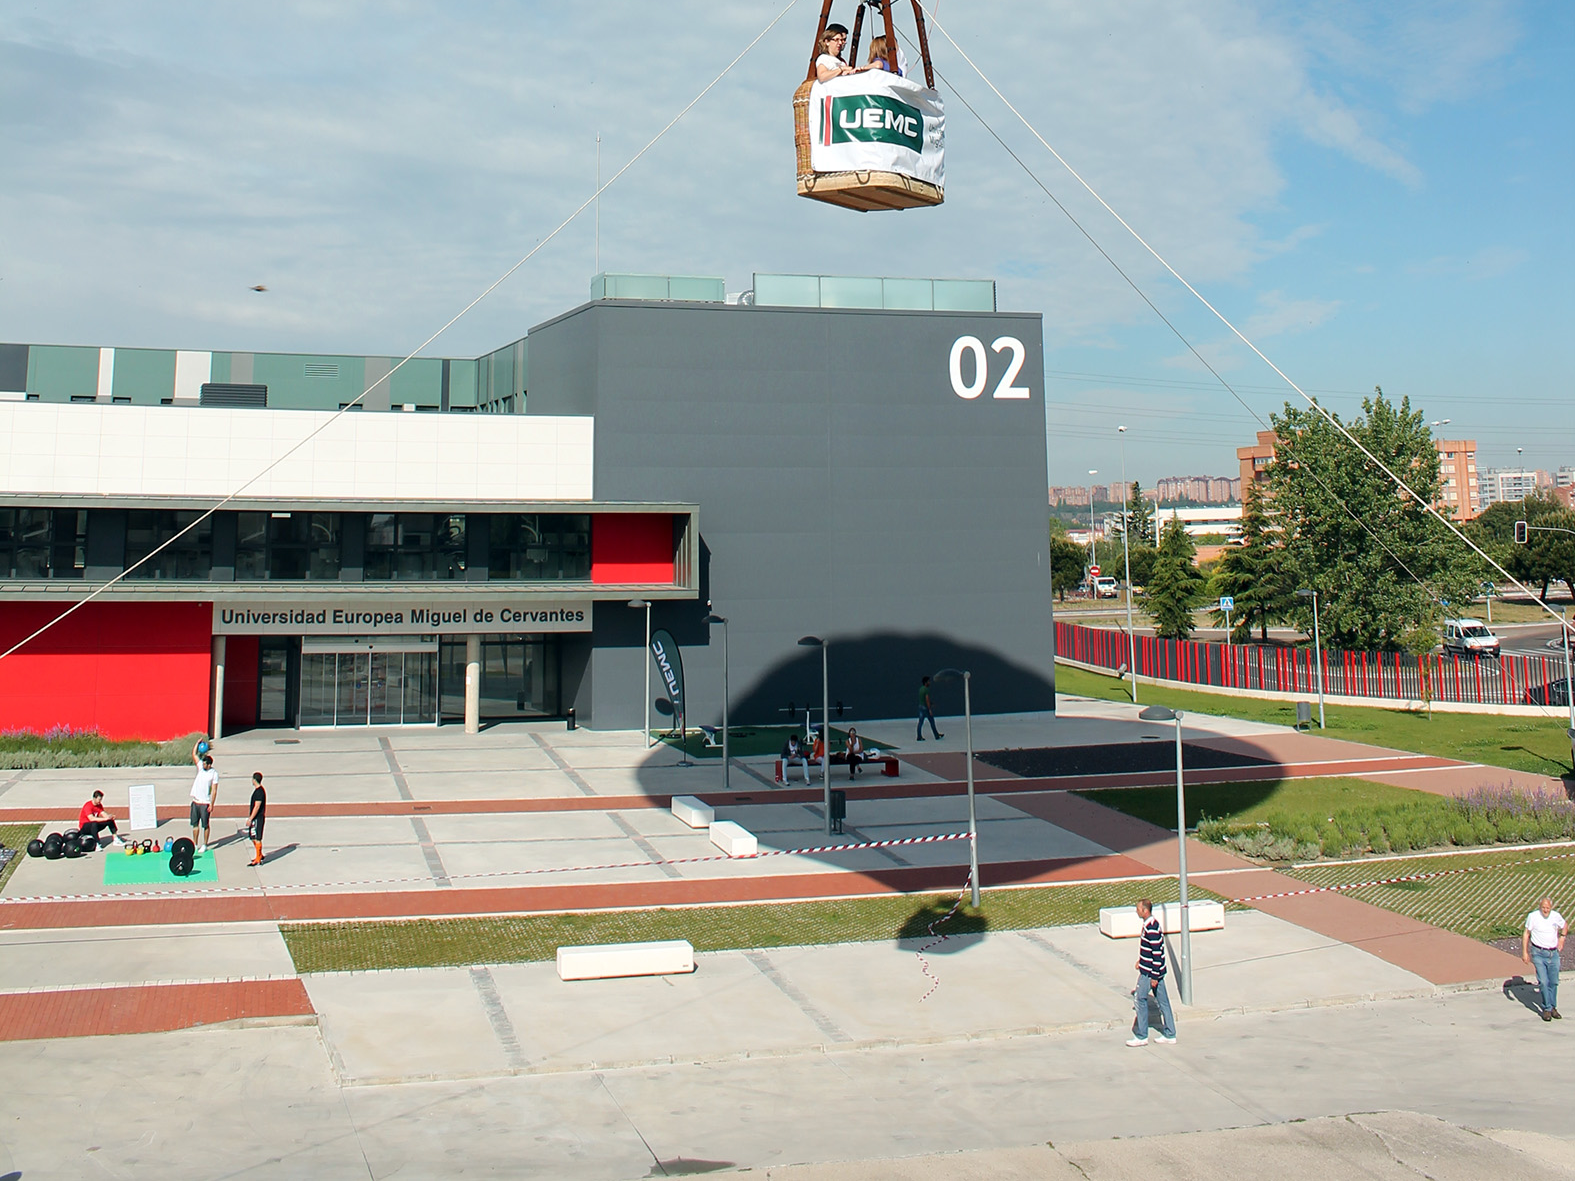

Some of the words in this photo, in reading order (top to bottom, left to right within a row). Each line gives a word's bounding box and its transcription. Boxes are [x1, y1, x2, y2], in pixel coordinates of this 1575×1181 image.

[839, 108, 918, 138] UEMC
[949, 335, 1030, 399] 02
[221, 609, 327, 624] Universidad
[332, 609, 404, 627] Europea
[410, 609, 467, 627] Miguel
[473, 609, 494, 623] de
[500, 608, 585, 623] Cervantes
